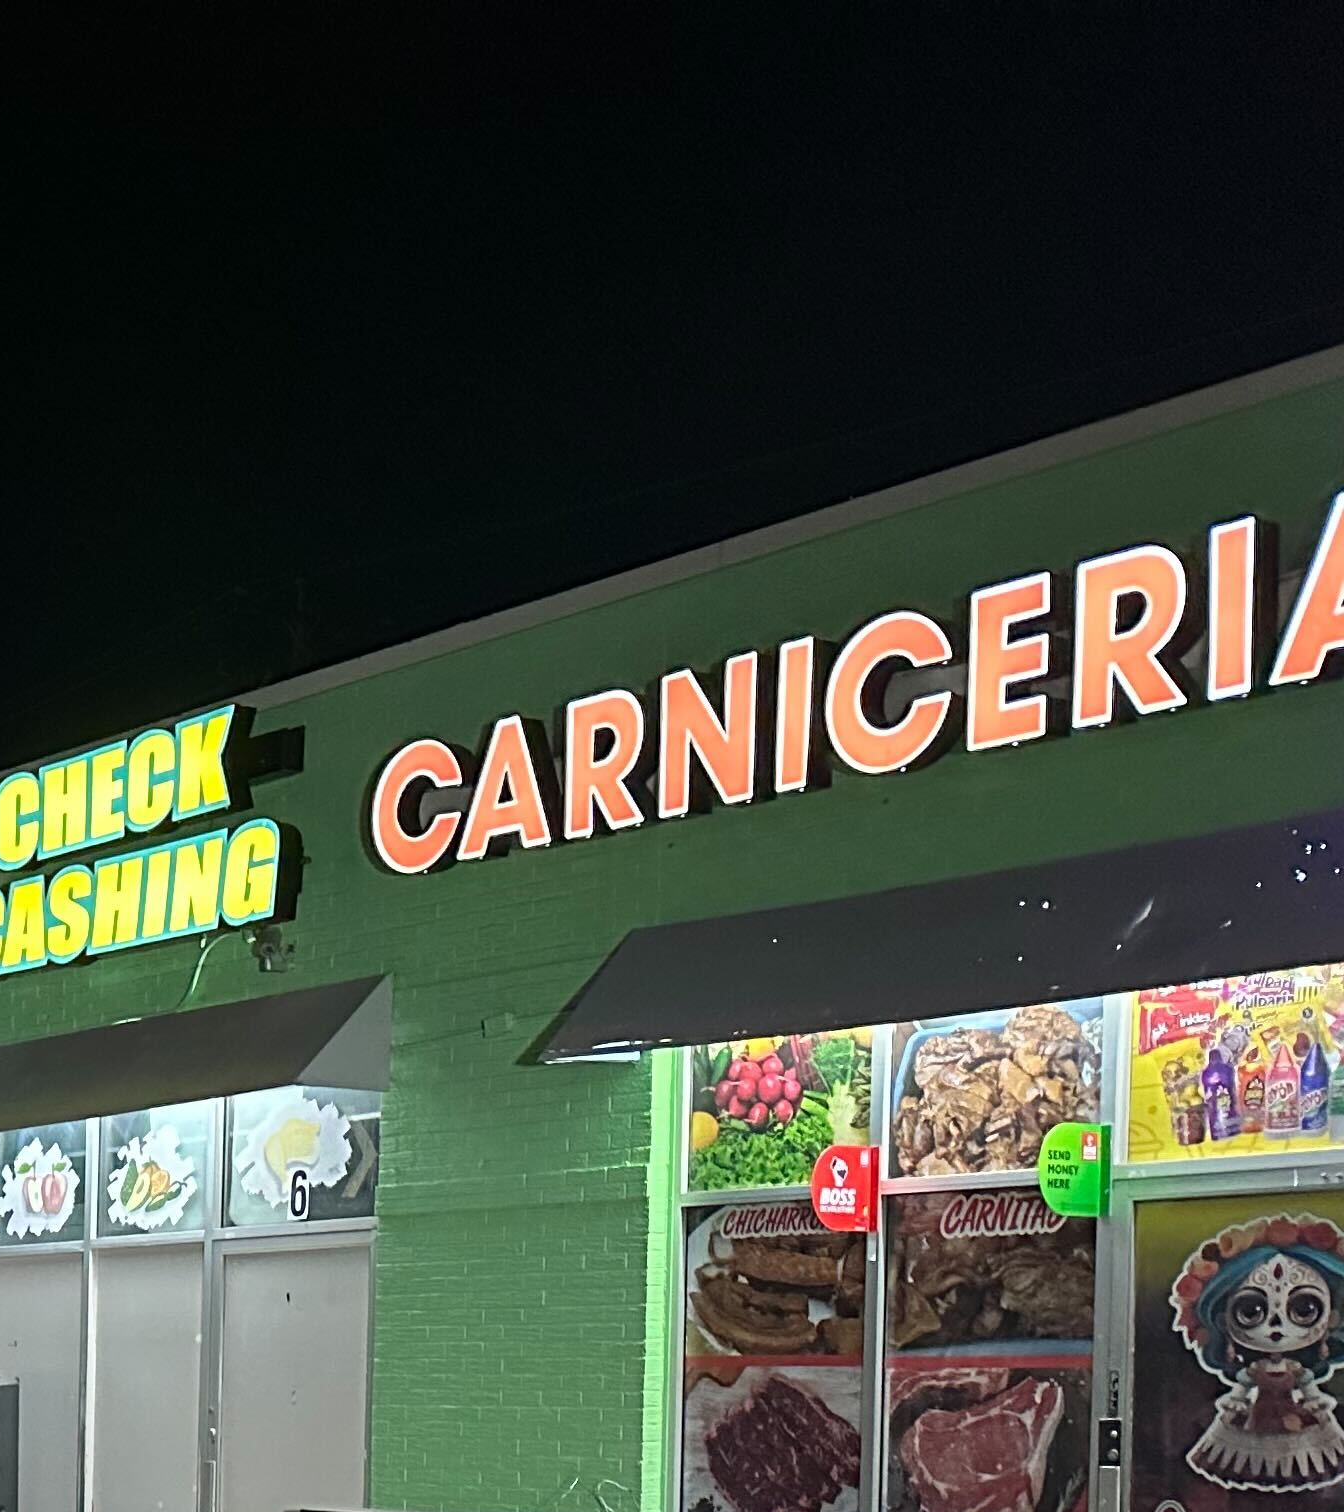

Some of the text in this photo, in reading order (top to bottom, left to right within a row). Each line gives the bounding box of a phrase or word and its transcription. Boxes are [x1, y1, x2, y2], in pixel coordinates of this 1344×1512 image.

[1047, 1149, 1071, 1161] SEND
[1047, 1163, 1079, 1176] MONEY
[1047, 1178, 1070, 1189] HERE
[291, 1170, 307, 1217] 6
[819, 1187, 857, 1207] BOSS
